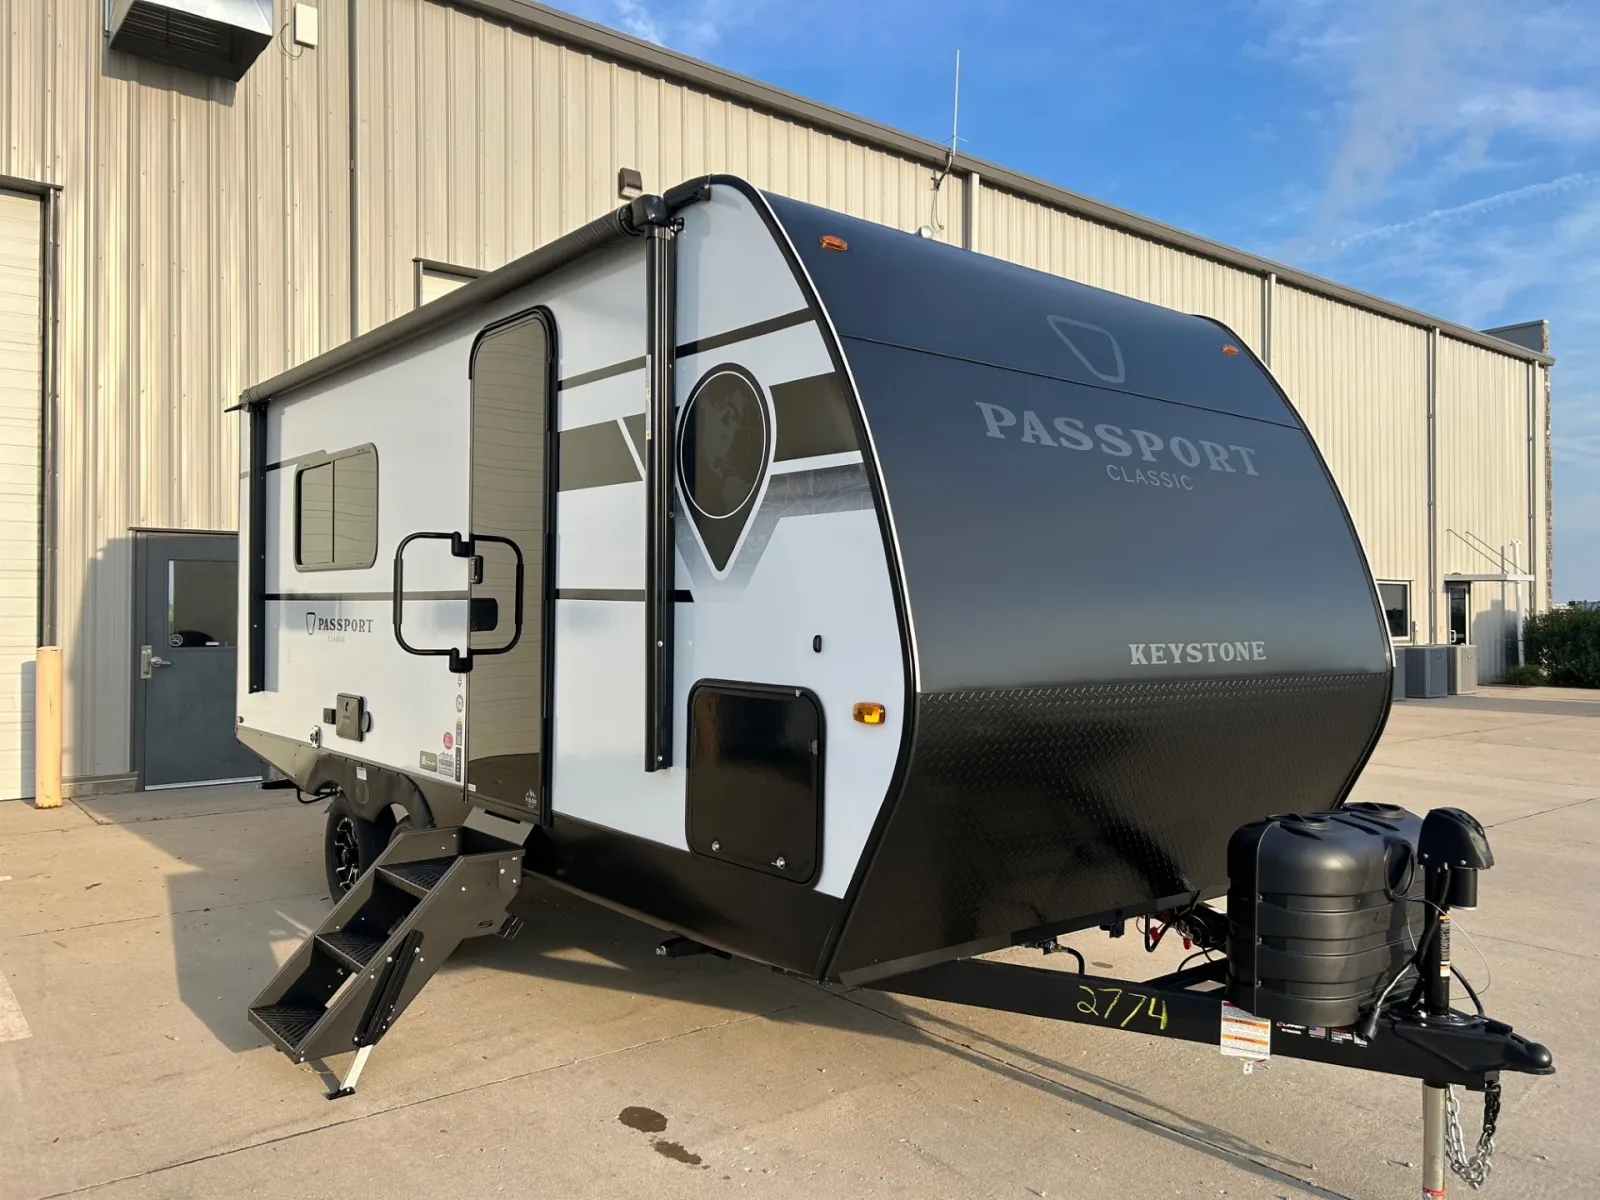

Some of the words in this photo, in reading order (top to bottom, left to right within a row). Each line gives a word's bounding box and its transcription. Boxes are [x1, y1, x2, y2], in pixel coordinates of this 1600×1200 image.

[974, 401, 1260, 477] PASSPORT
[1105, 464, 1194, 491] CLASSIC
[318, 617, 373, 633] PASSPORT
[1128, 641, 1267, 665] KEYSTONE
[1076, 985, 1168, 1030] 2774
